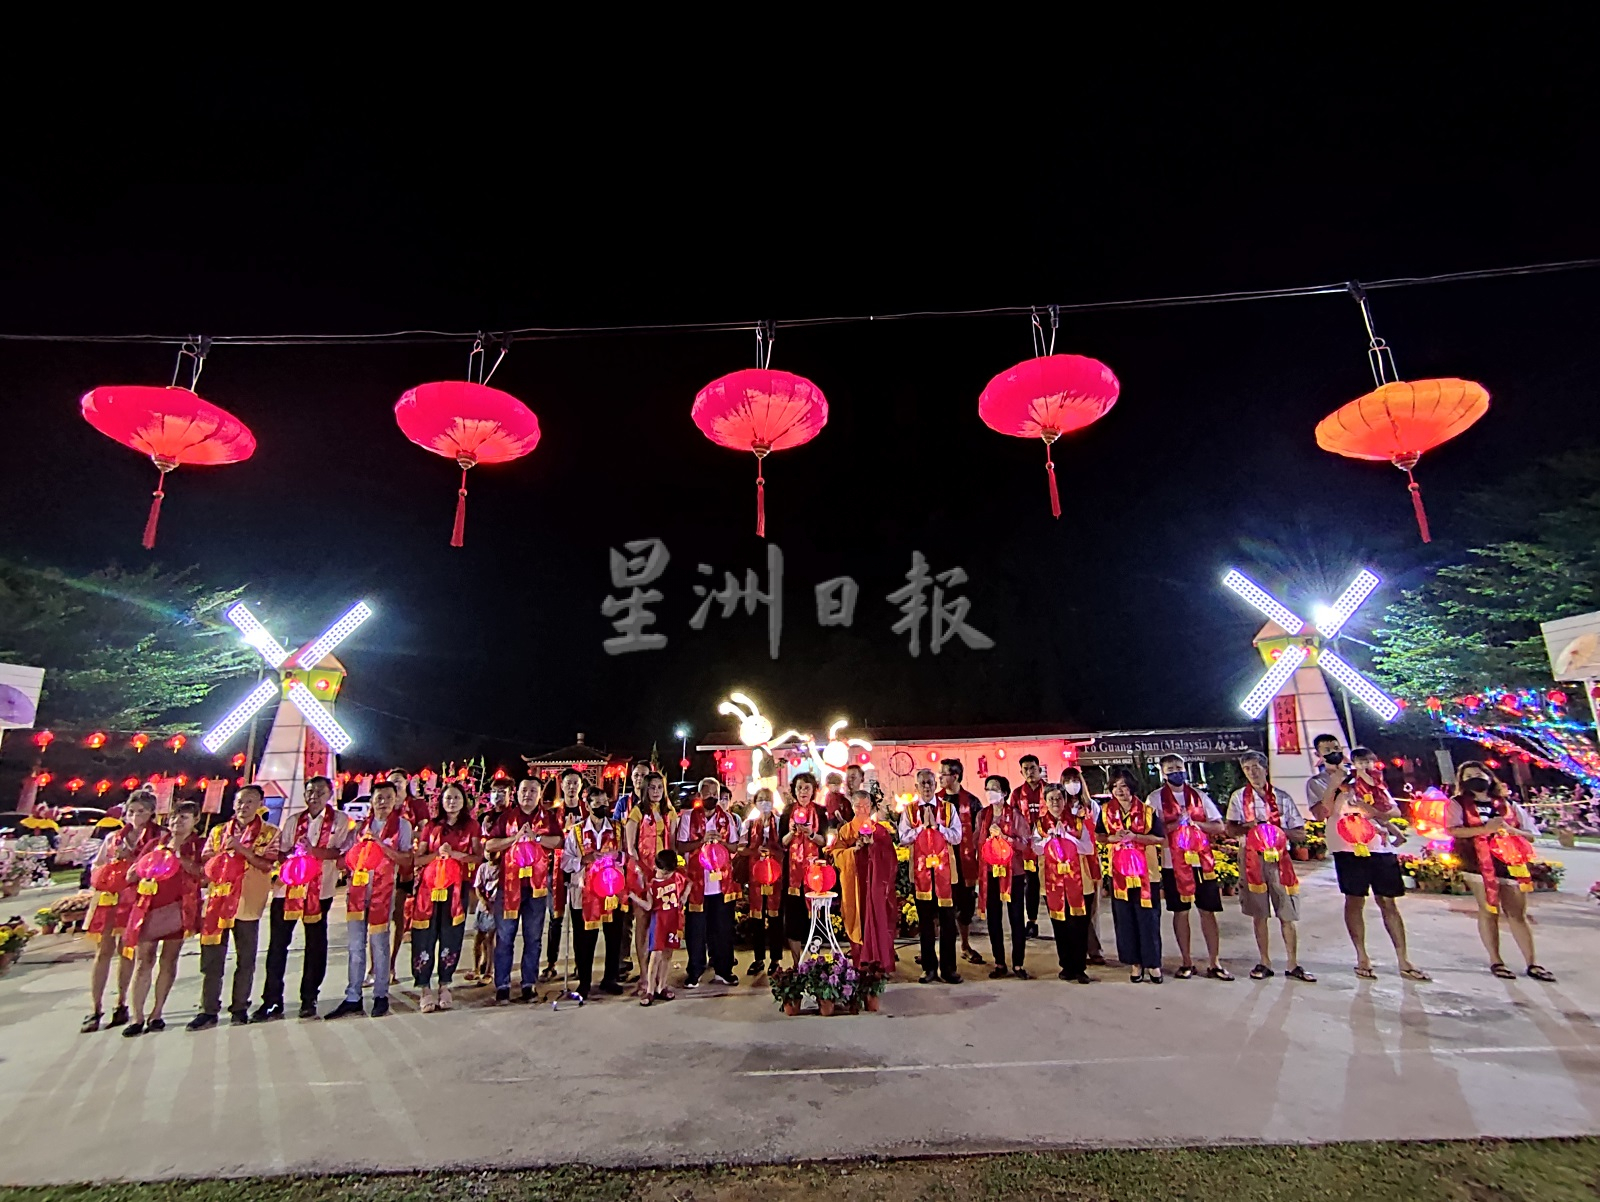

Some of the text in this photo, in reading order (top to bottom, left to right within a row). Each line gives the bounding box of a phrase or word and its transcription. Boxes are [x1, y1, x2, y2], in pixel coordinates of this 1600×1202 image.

[1099, 742, 1132, 754] Guang
[1135, 741, 1160, 752] Shan
[1161, 739, 1212, 752] (Malaysia)
[661, 893, 678, 910] 24
